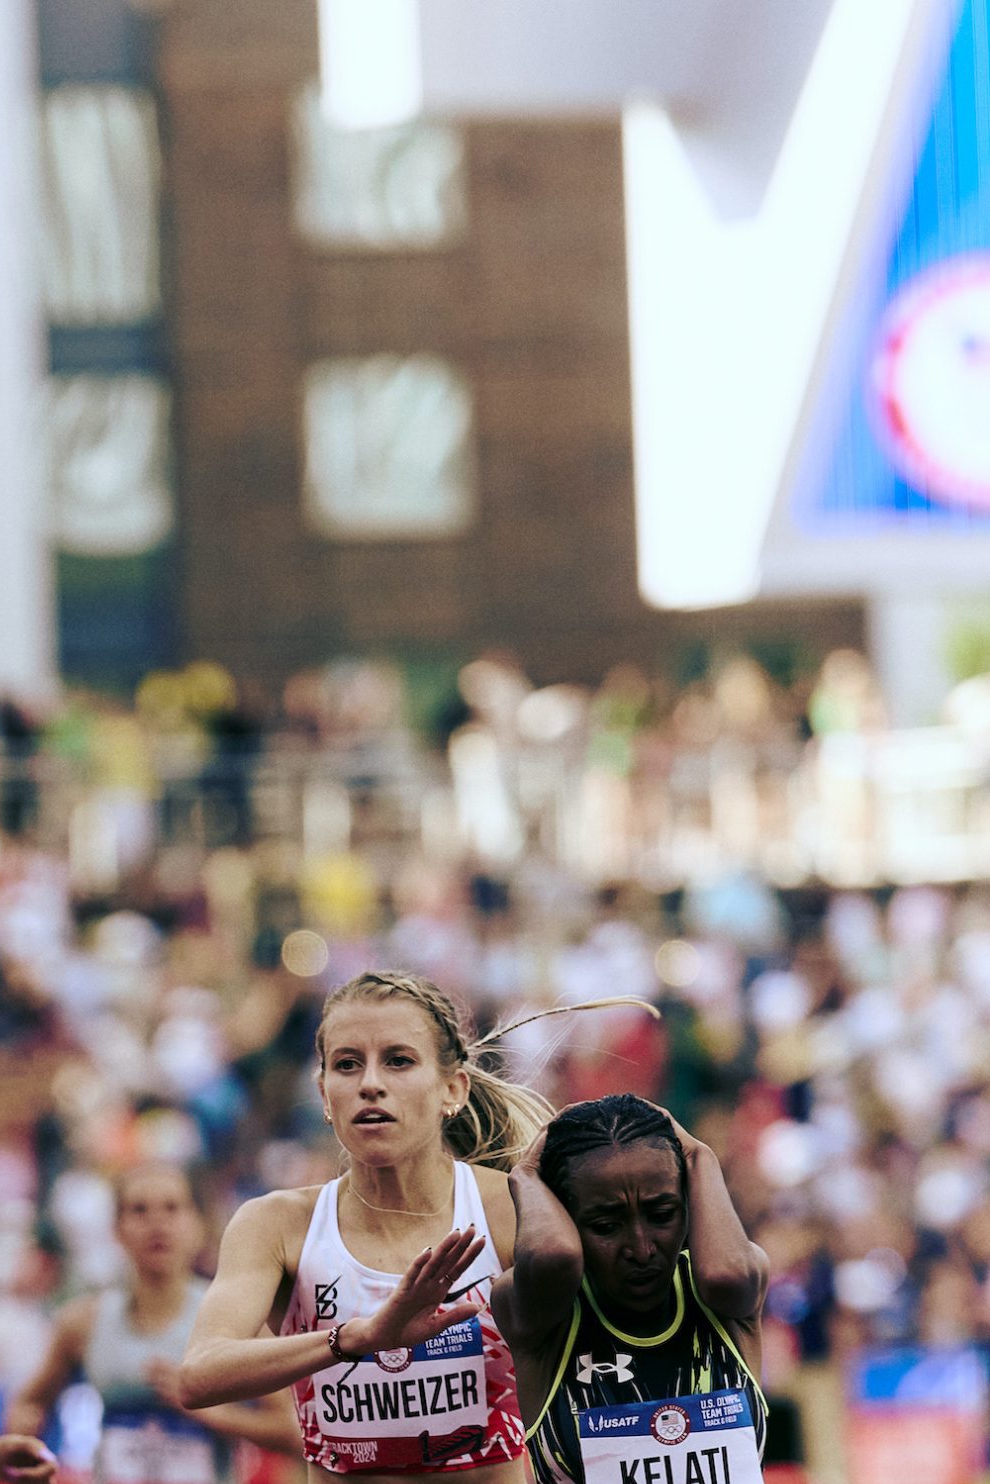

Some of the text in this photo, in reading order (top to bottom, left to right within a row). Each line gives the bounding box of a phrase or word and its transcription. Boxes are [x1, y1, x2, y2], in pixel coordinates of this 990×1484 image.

[425, 1332, 474, 1349] TEAM TRIALS
[321, 1369, 479, 1424] SCHWEIZER
[700, 1398, 716, 1410] U.S.
[701, 1408, 723, 1420] TEAM
[604, 1415, 640, 1429] USATF
[704, 1418, 721, 1427] TRACK
[353, 1450, 377, 1464] 2024
